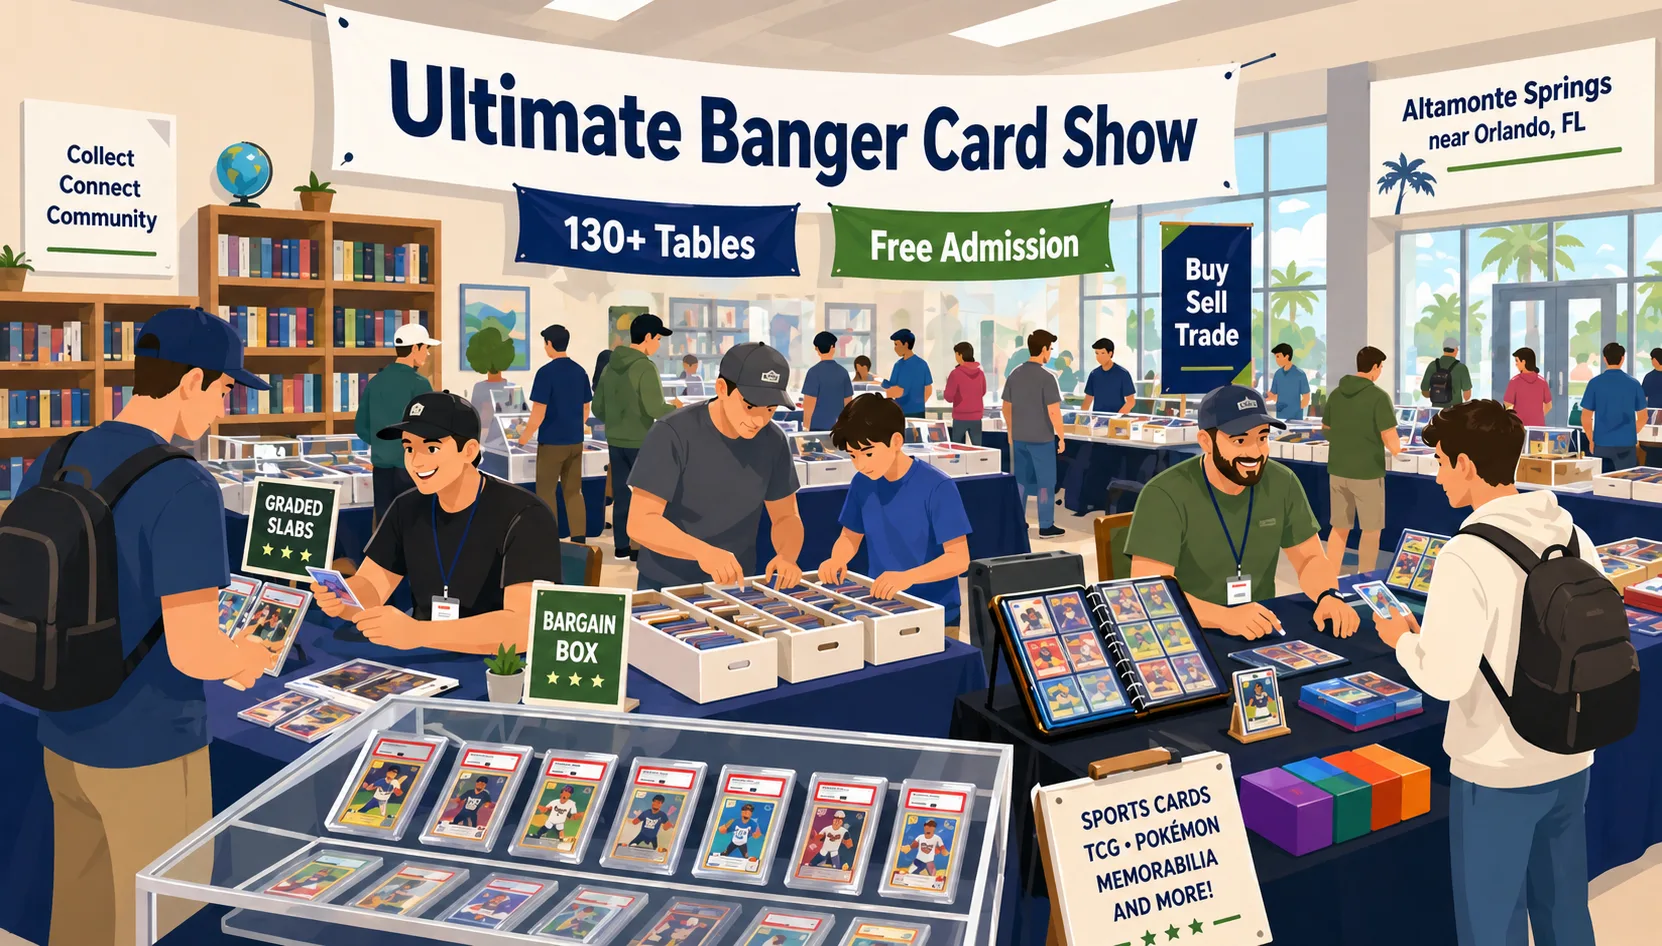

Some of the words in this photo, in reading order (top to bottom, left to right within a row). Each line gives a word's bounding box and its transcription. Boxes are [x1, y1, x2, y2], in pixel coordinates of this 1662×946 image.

[1402, 87, 1518, 122] Altamonte
[1523, 74, 1613, 110] Springs
[390, 58, 682, 162] Ultimate
[700, 95, 909, 188] Banger
[923, 105, 1048, 172] Card
[1062, 103, 1198, 169] Show
[1429, 130, 1470, 151] near
[1474, 115, 1556, 144] Orlando,
[1562, 110, 1586, 134] FL
[66, 144, 135, 168] Collect
[59, 174, 141, 198] Connect
[46, 204, 158, 234] Community
[564, 215, 646, 254] 130+
[654, 223, 756, 260] Tables
[871, 229, 933, 263] Free
[939, 227, 1079, 263] Admission
[1186, 257, 1230, 287] Buy
[1185, 289, 1227, 314] Sell
[1174, 322, 1240, 347] Trade
[265, 494, 324, 517] GRADED
[266, 516, 315, 540] SLABS
[542, 610, 617, 635] BARGAIN
[555, 639, 599, 664] BOX
[1080, 798, 1151, 831] SPORTS
[1153, 785, 1211, 814] CARDS
[1083, 838, 1121, 862] TCG
[1134, 815, 1221, 851] POKÉMON
[1096, 848, 1219, 894] MEMORABILIA
[1113, 896, 1151, 923] AND
[1155, 880, 1214, 912] MORE!
